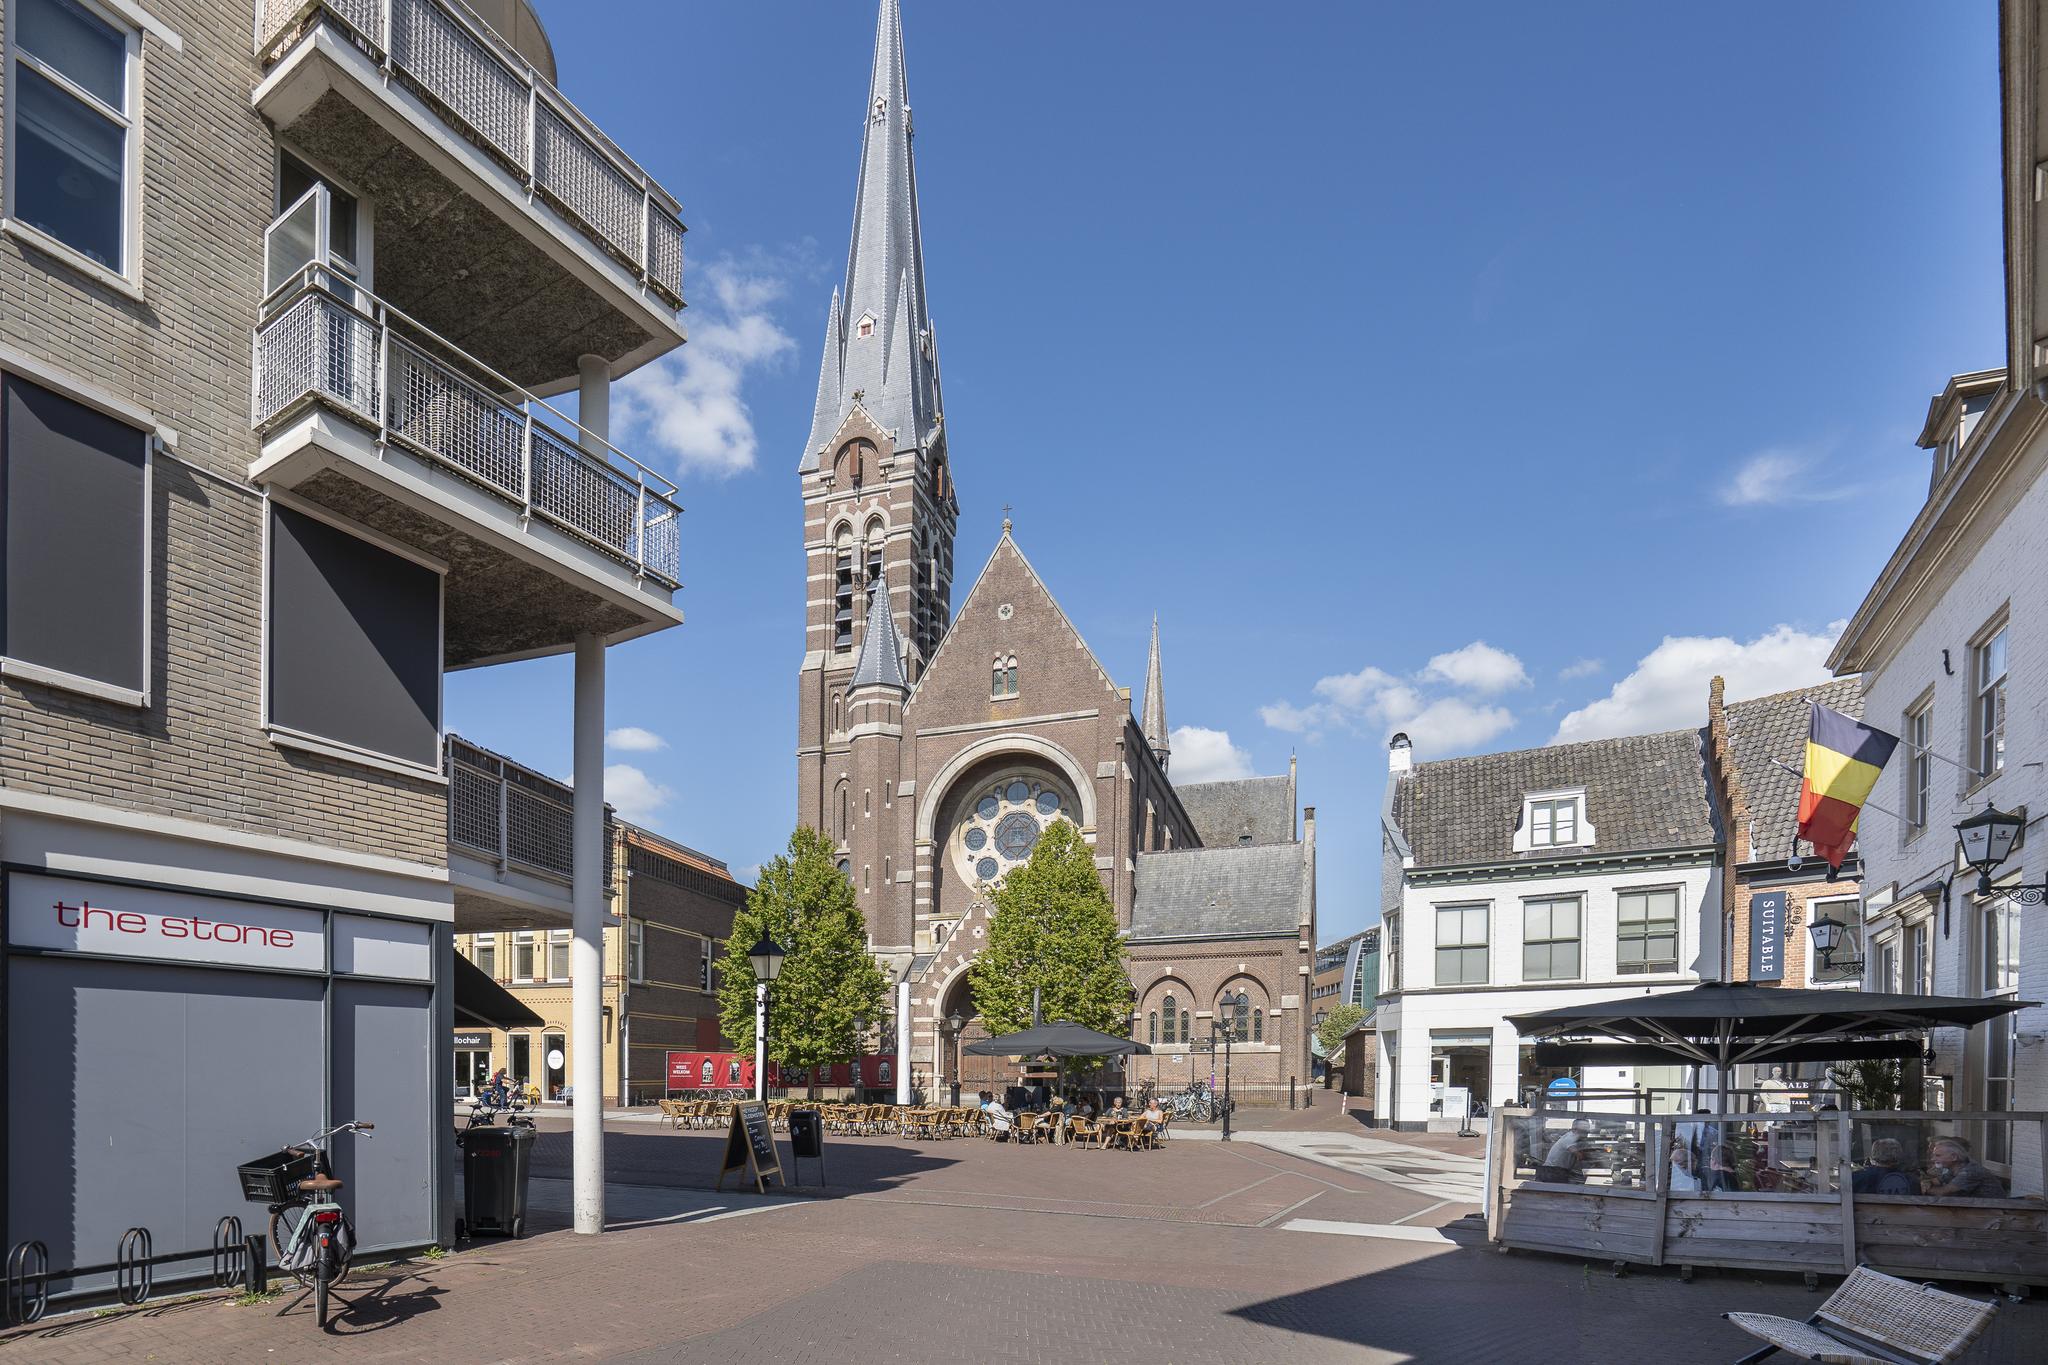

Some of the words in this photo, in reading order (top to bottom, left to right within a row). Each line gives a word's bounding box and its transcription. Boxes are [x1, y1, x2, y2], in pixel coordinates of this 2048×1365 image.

[53, 901, 146, 934] the
[161, 916, 294, 948] stone
[1761, 900, 1775, 972] SUITABLE
